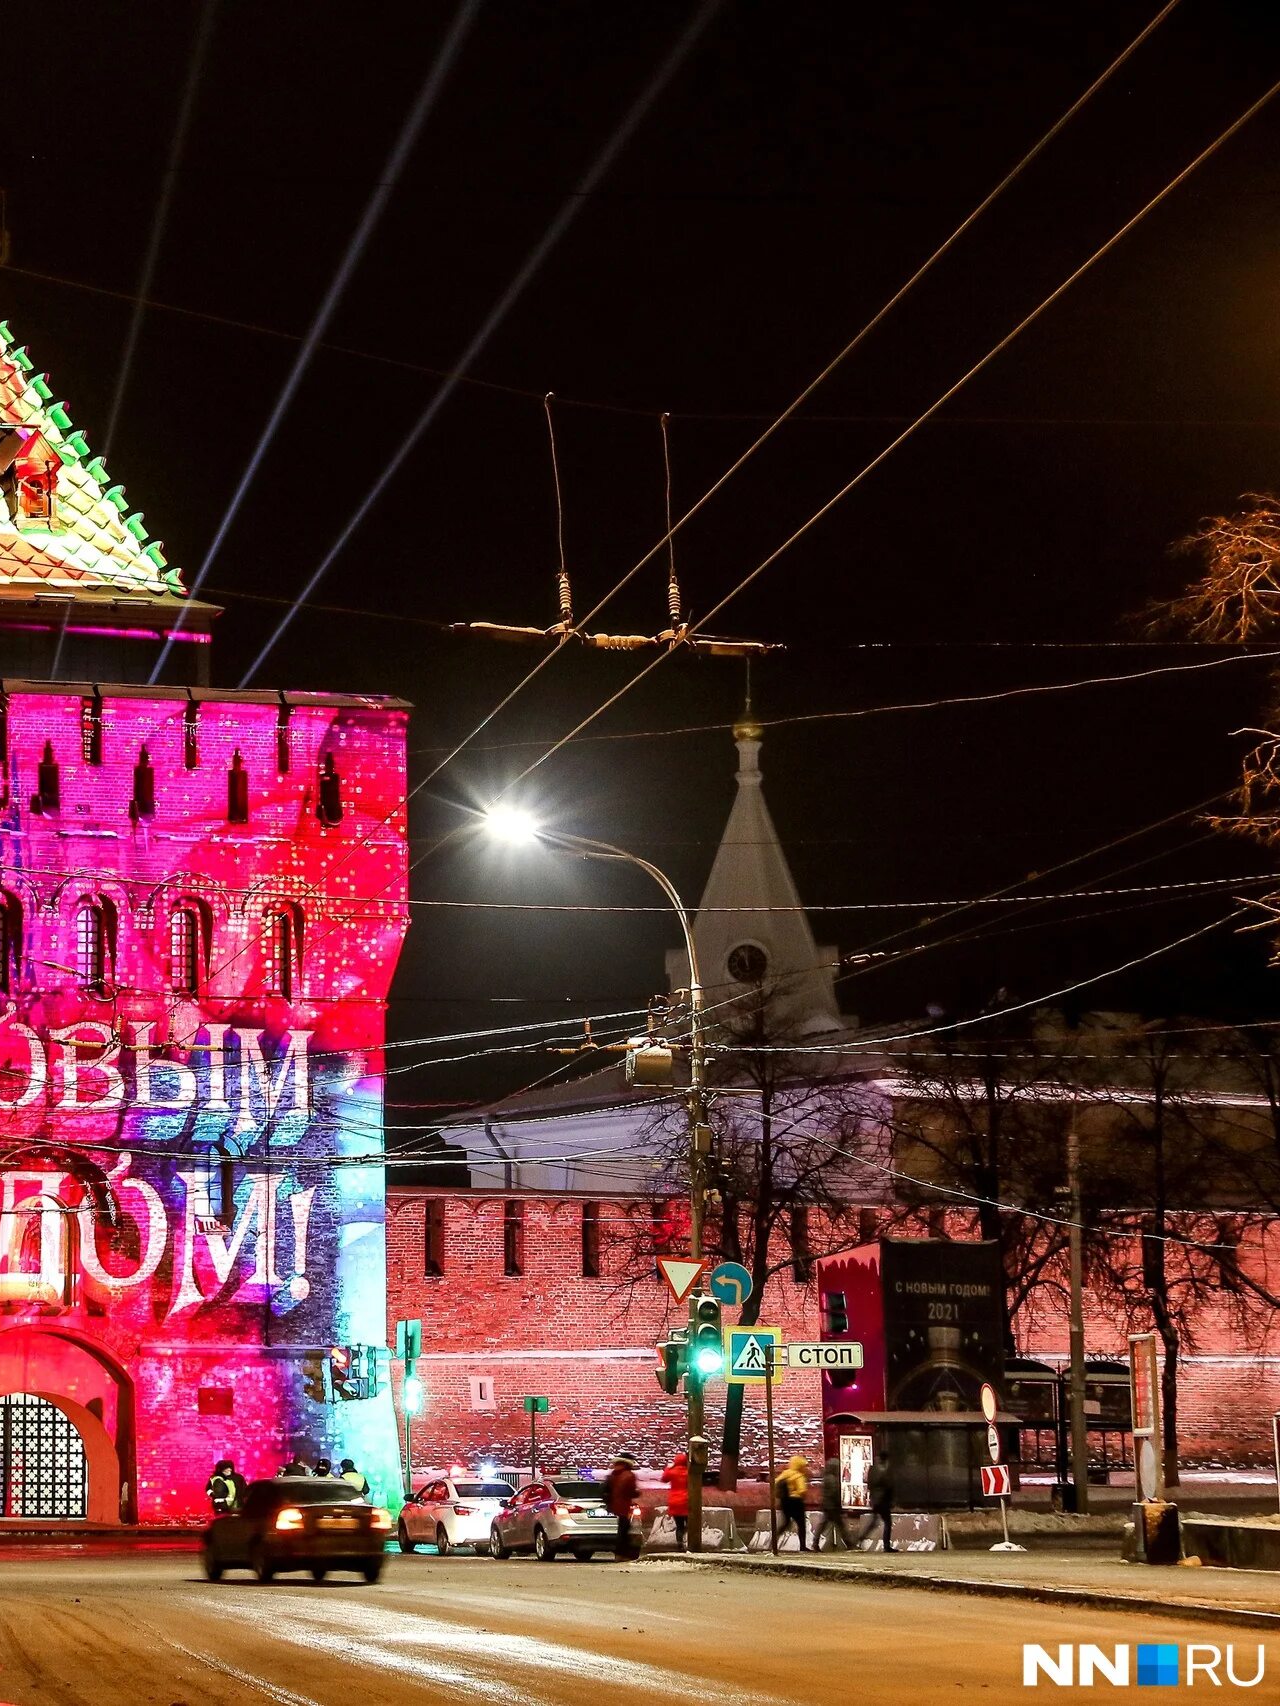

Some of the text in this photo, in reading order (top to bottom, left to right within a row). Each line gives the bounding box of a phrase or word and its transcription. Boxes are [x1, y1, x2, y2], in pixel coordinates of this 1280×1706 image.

[895, 1282, 990, 1297] С НОВЫМ ГОДОМ!
[928, 1302, 959, 1320] 2021
[799, 1348, 853, 1364] СТОП
